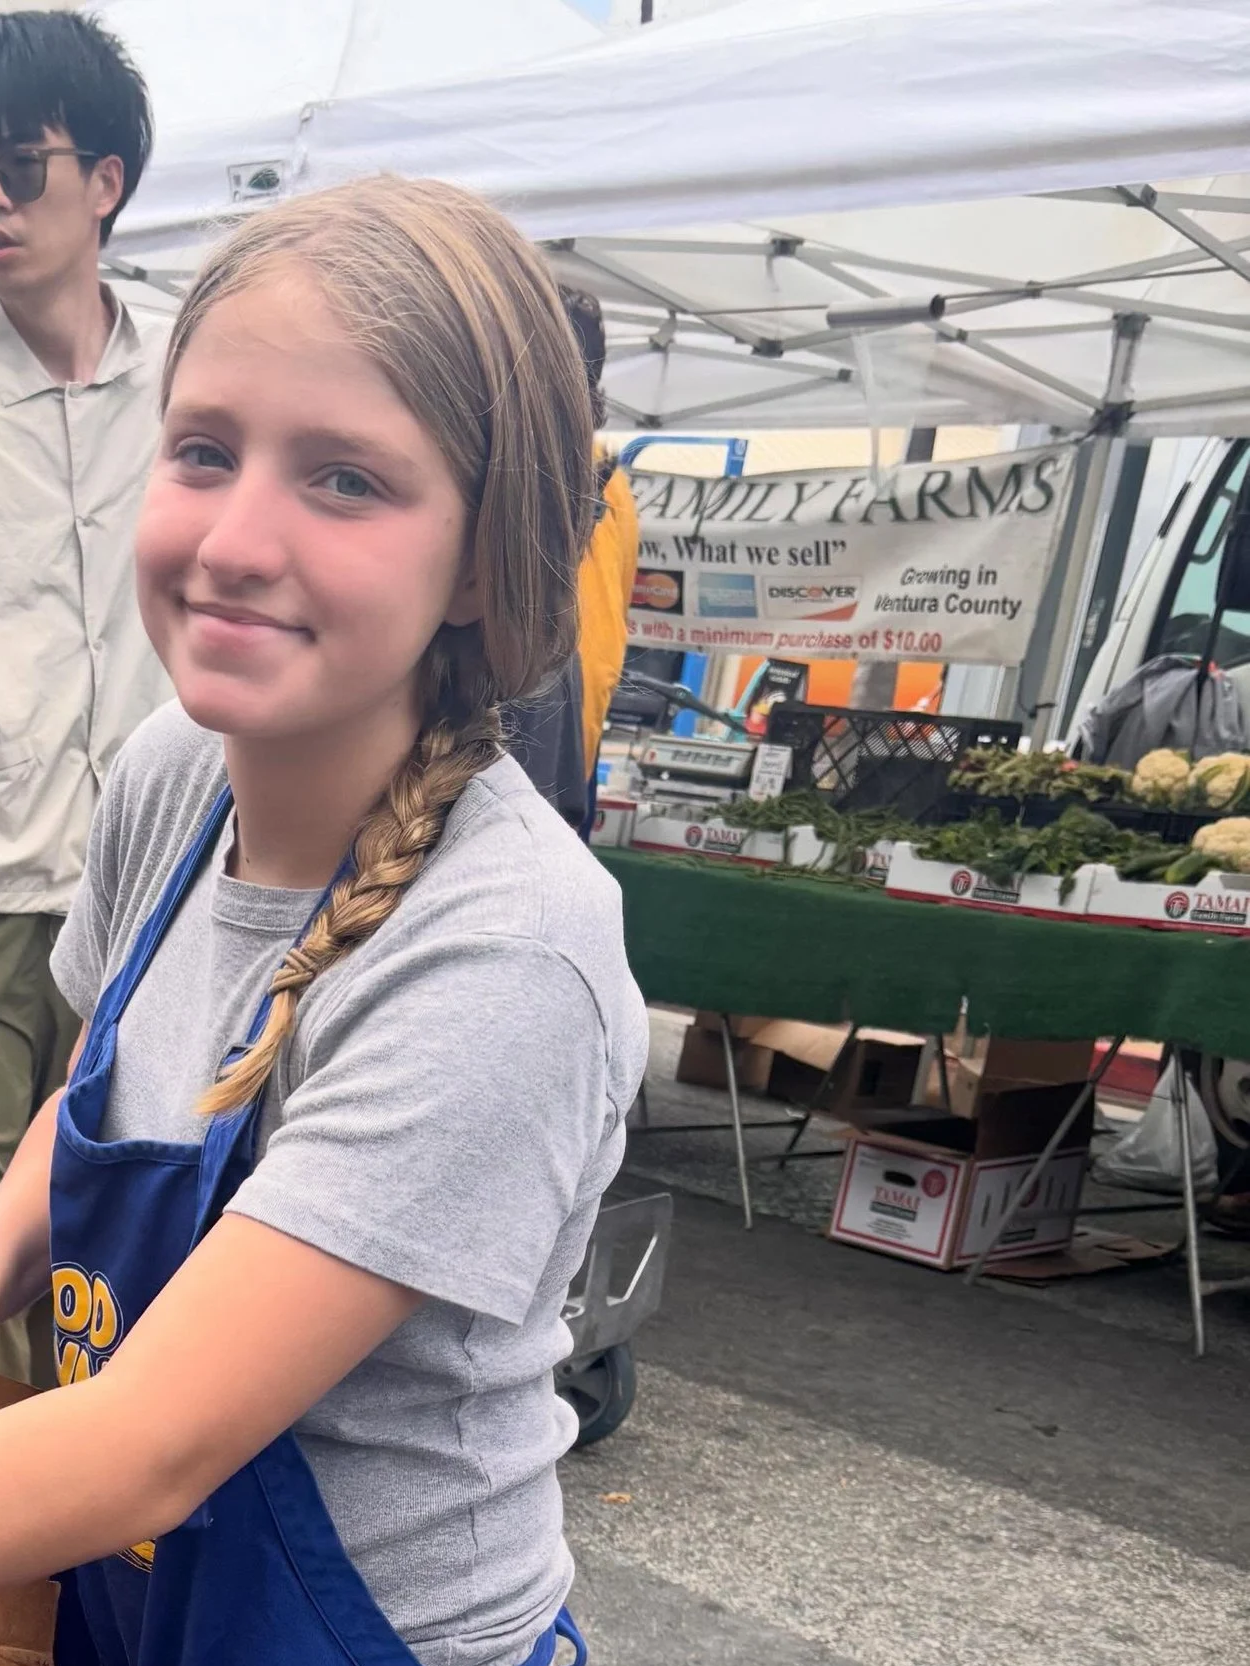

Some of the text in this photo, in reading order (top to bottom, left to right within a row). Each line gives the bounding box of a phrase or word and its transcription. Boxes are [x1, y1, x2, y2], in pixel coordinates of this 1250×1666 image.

[828, 457, 1060, 524] FARMS
[673, 535, 738, 565] What
[746, 546, 780, 565] we
[768, 586, 856, 598] DISCOVER
[901, 564, 998, 590] Growing in
[874, 593, 1022, 620] Ventura County
[642, 621, 674, 639] with
[677, 628, 686, 641] a
[690, 625, 774, 646] minimum
[776, 631, 854, 650] purchase
[859, 630, 879, 649] of
[883, 628, 943, 652] $10.00
[51, 1266, 119, 1350] OD
